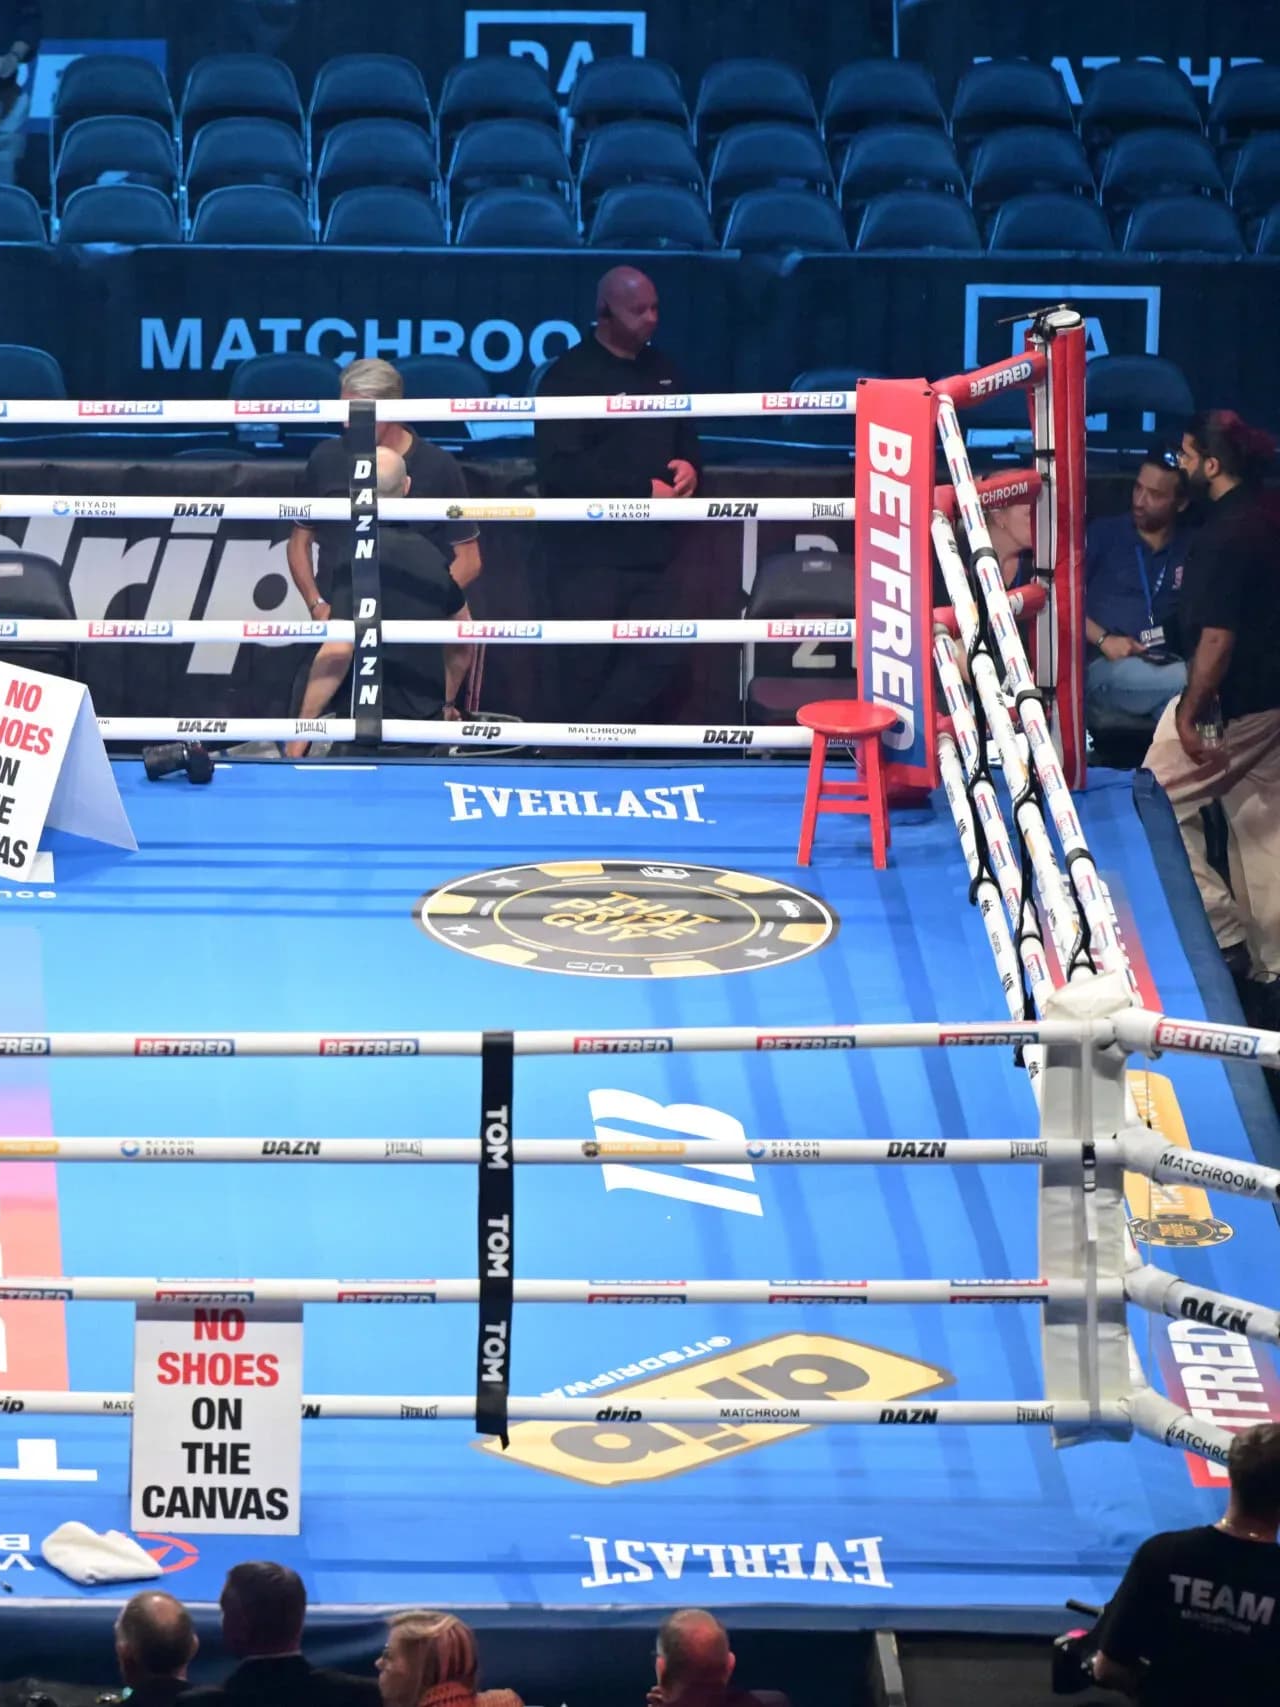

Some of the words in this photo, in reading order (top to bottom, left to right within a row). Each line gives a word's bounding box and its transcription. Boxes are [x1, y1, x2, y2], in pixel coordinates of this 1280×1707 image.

[141, 318, 582, 372] MATCHROO
[970, 362, 1031, 398] BETFRED
[80, 401, 162, 414] BETFRED
[236, 400, 318, 413] BETFRED
[452, 399, 534, 411] BETFRED
[609, 396, 690, 411] BETFRED
[764, 393, 845, 409] BETFRED
[173, 503, 225, 517] DAZN
[278, 503, 312, 519] EVERLAST
[354, 460, 373, 559] DAZN
[707, 503, 758, 518] DAZN
[812, 502, 845, 518] EVERLAST
[868, 423, 915, 750] BETFRED
[91, 622, 171, 636] BETFRED
[247, 621, 326, 635] BETFRED
[461, 622, 540, 636] BETFRED
[616, 622, 696, 636] BETFRED
[771, 621, 851, 636] BETFRED
[358, 598, 379, 705] DAZN
[6, 679, 42, 712] NO
[177, 720, 227, 734] DAZN
[295, 719, 327, 734] EVERLAST
[462, 723, 501, 739] drip
[703, 730, 754, 744] DAZN
[444, 781, 706, 823] EVERLAST
[605, 890, 719, 927] THAT
[542, 913, 650, 943] GUY
[136, 1040, 232, 1055] BETFRED
[322, 1040, 417, 1055] BETFRED
[1158, 1026, 1258, 1056] BETFRED
[487, 1105, 508, 1169] TOM
[145, 1147, 195, 1156] SEASON
[262, 1141, 320, 1155] DAZN
[771, 1148, 820, 1157] SEASON
[887, 1142, 947, 1158] DAZN
[1010, 1140, 1048, 1159] EVERLAST
[1160, 1153, 1257, 1190] MATCHROOM
[487, 1214, 509, 1278] TOM
[1181, 1297, 1253, 1332] DAZN
[193, 1308, 245, 1341] NO
[482, 1321, 506, 1382] TOM
[157, 1351, 280, 1387] SHOES
[191, 1397, 243, 1431] ON
[400, 1404, 438, 1419] EVERLAST
[596, 1406, 642, 1422] drip
[720, 1408, 800, 1418] MATCHROOM
[879, 1408, 939, 1424] DAZN
[1016, 1404, 1055, 1423] EVERLAST
[181, 1441, 251, 1475] THE
[141, 1485, 289, 1521] CANVAS
[581, 1535, 893, 1589] EVERLAST
[1169, 1574, 1276, 1625] TEAM
